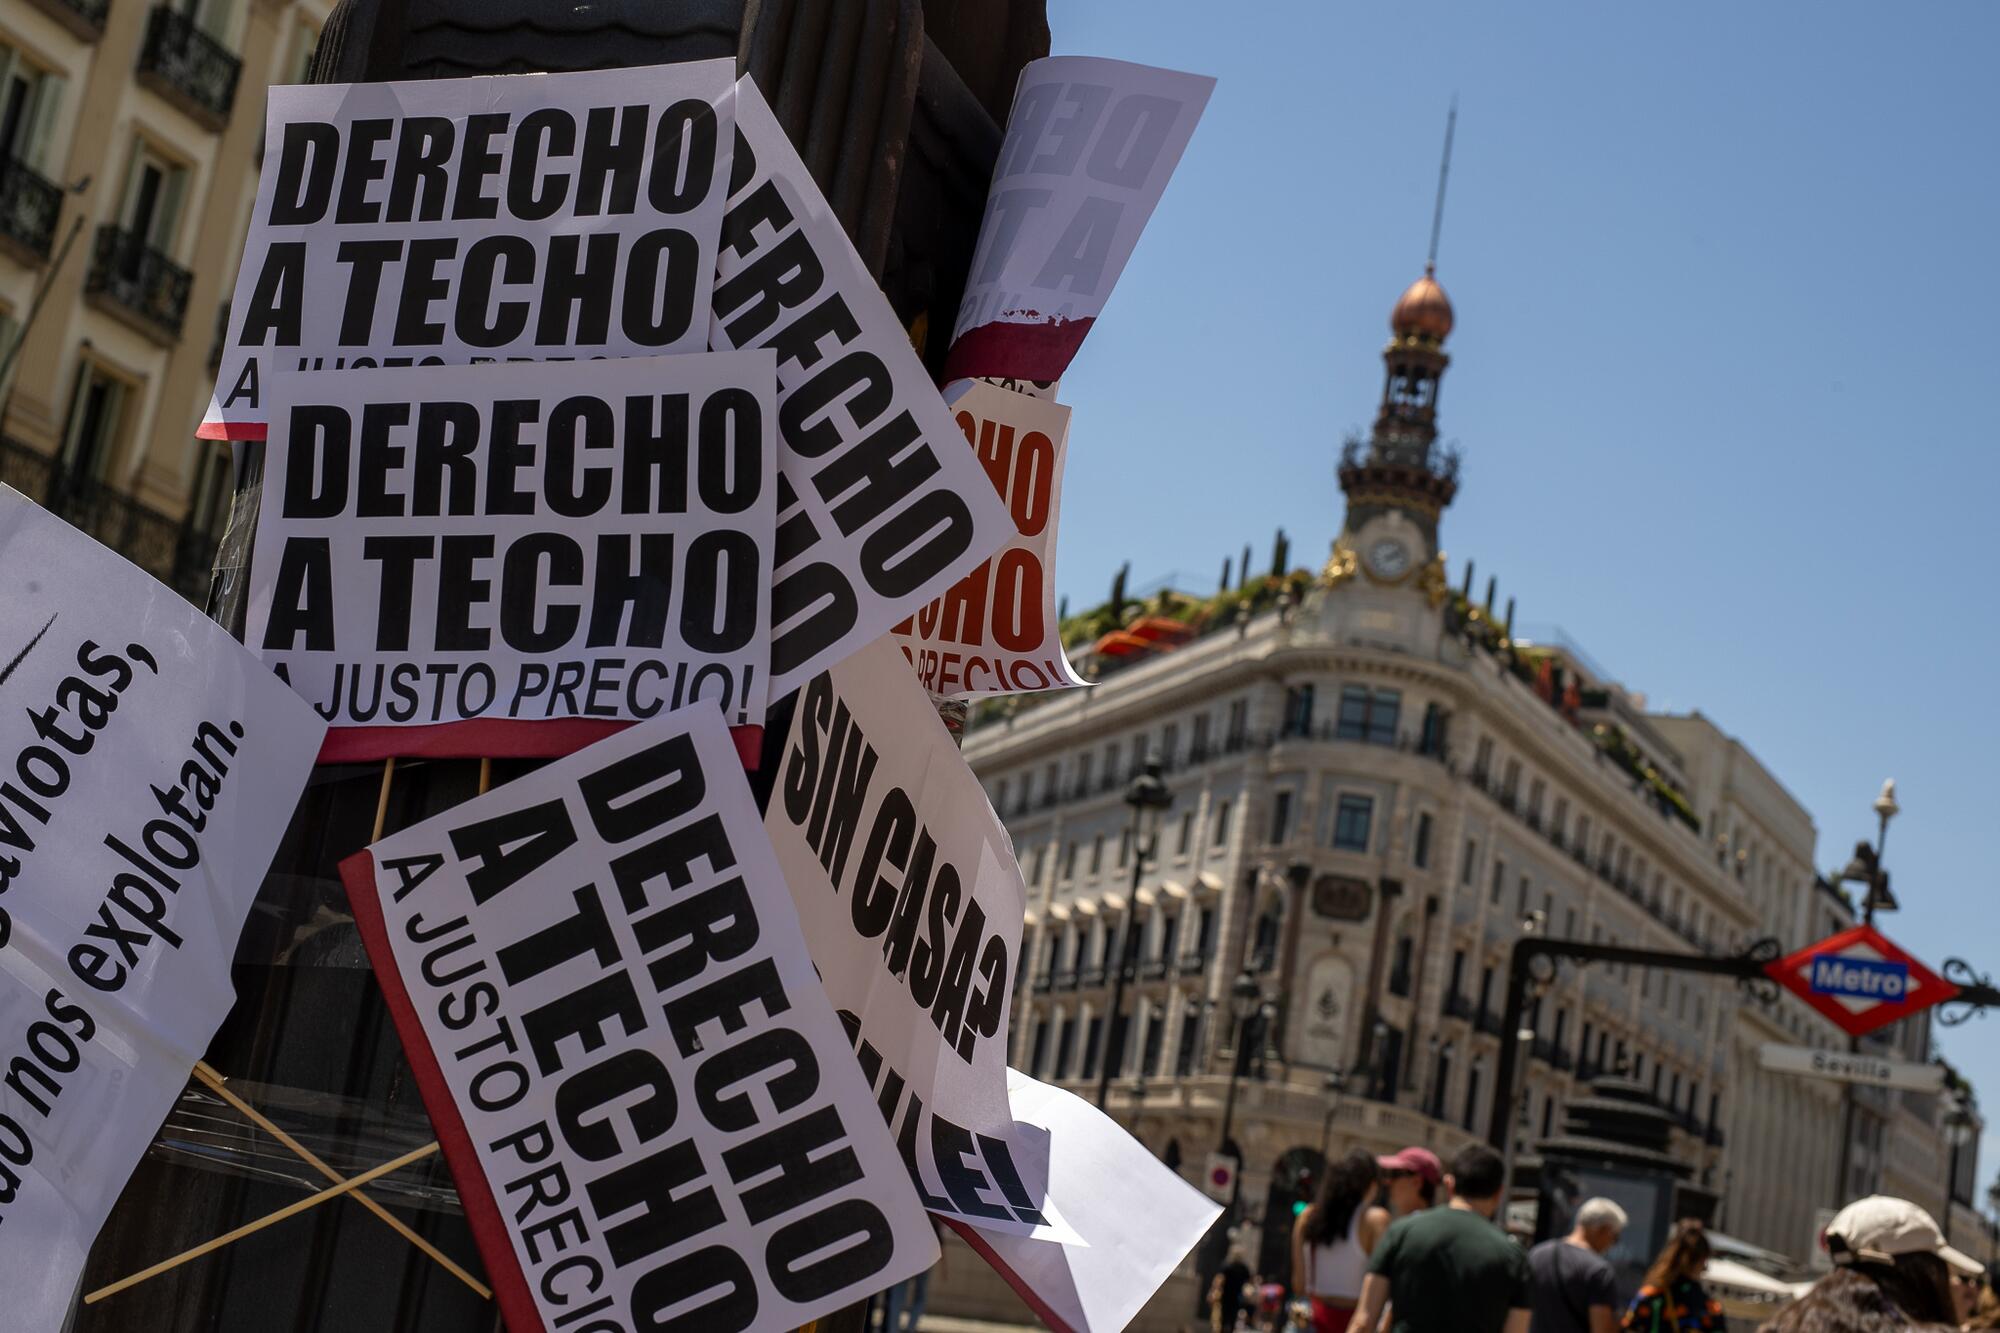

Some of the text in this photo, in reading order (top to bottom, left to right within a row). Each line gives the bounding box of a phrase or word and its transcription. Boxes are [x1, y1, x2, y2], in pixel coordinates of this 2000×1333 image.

[268, 98, 718, 226] DERECHO
[238, 228, 699, 347] A TECHO
[223, 357, 260, 408] A
[282, 387, 762, 519] DERECHO
[262, 537, 335, 651] A
[363, 529, 760, 653] TECHO
[314, 662, 496, 722] JUSTO
[508, 658, 755, 725] PRECIO!
[5, 987, 96, 1118] nos
[67, 720, 245, 992] explotan.
[381, 852, 446, 904] A
[784, 669, 878, 893] SIN
[851, 786, 1008, 1067] CASA?
[405, 912, 531, 1113] JUSTO
[577, 731, 895, 1304] DERECHO
[1816, 962, 1902, 996] Metro
[448, 797, 759, 1333] A TECHO
[1814, 1055, 1890, 1079] Sevilla
